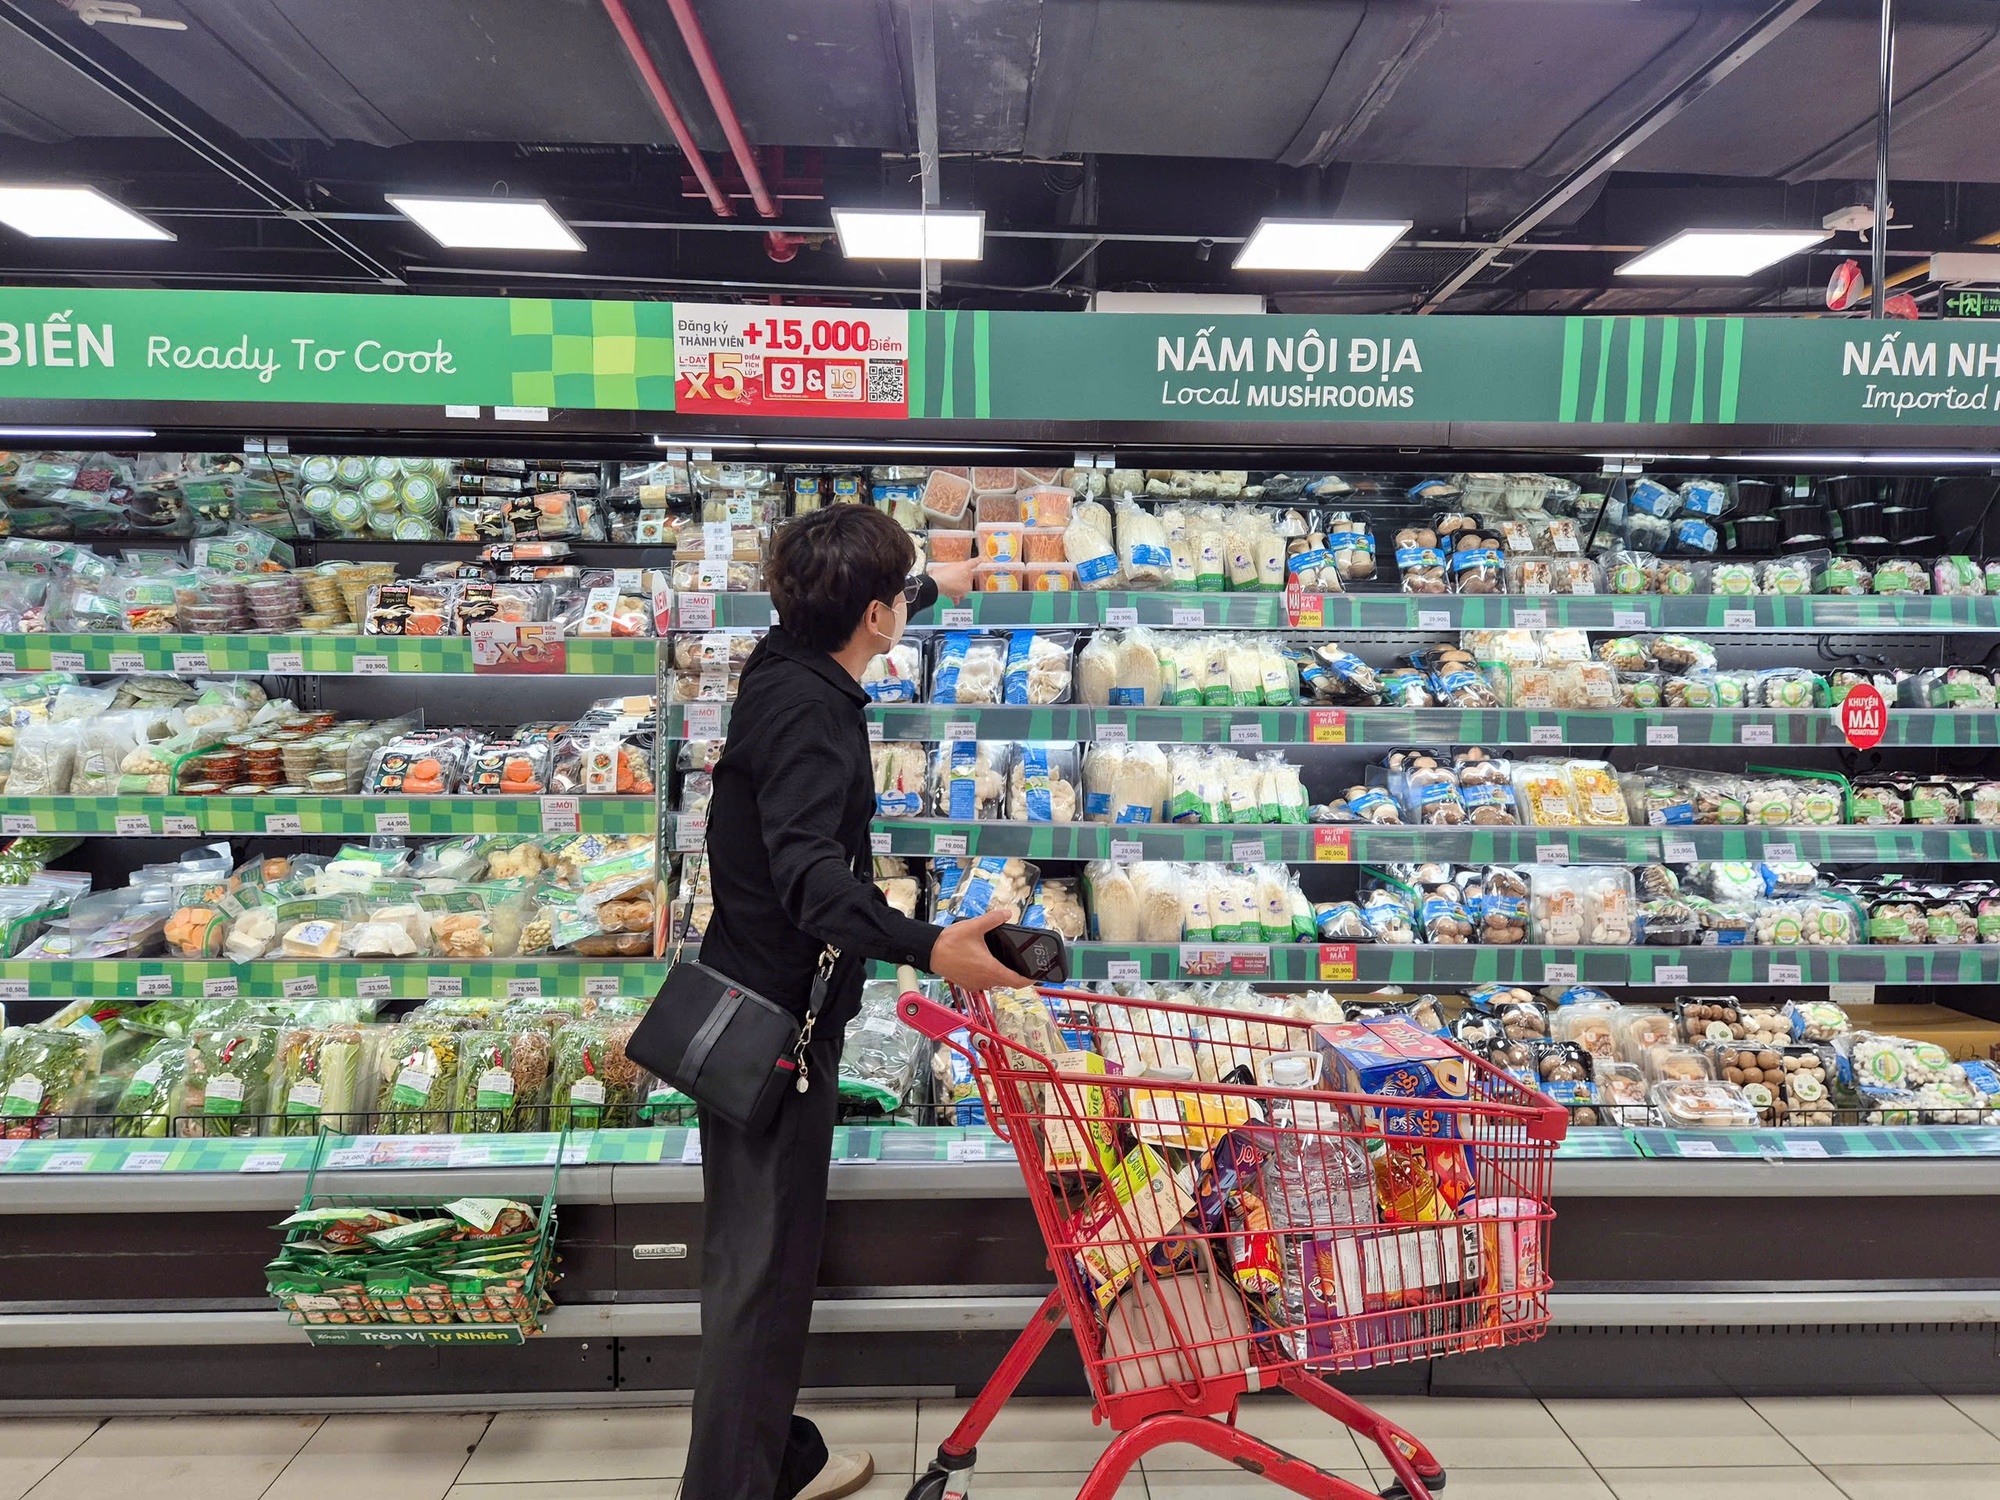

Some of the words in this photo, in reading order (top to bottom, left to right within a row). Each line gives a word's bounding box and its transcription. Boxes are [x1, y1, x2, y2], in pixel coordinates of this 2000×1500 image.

[678, 319, 711, 334] Đăng
[713, 320, 728, 334] ký
[743, 318, 871, 355] +15,000
[869, 337, 902, 352] Điểm
[0, 309, 114, 367] BIẾN
[147, 334, 281, 383] Ready
[291, 339, 345, 372] To
[354, 338, 457, 375] Cook
[679, 335, 720, 347] THÀNH
[721, 336, 744, 348] VIÊN
[678, 356, 707, 364] L-DAY
[1157, 326, 1254, 372] NẤM
[1266, 328, 1338, 382] NỘI
[1348, 338, 1423, 382] ĐỊA
[1842, 331, 1937, 376] NẤM
[780, 367, 796, 390] 9
[805, 369, 824, 391] &
[830, 368, 857, 390] 19
[1162, 378, 1241, 405] Local
[1247, 385, 1414, 408] MUSHROOMS
[1862, 384, 1989, 418] Imported
[693, 596, 709, 605] MỚI
[1848, 695, 1879, 707] KHUYẾN
[1849, 706, 1879, 728] MÃI
[556, 801, 573, 809] MỚI
[1033, 943, 1049, 971] 16:31
[359, 1332, 403, 1341] Tròn
[404, 1332, 426, 1342] Vị
[427, 1332, 452, 1342] Tự
[455, 1331, 509, 1341] Nhiên
